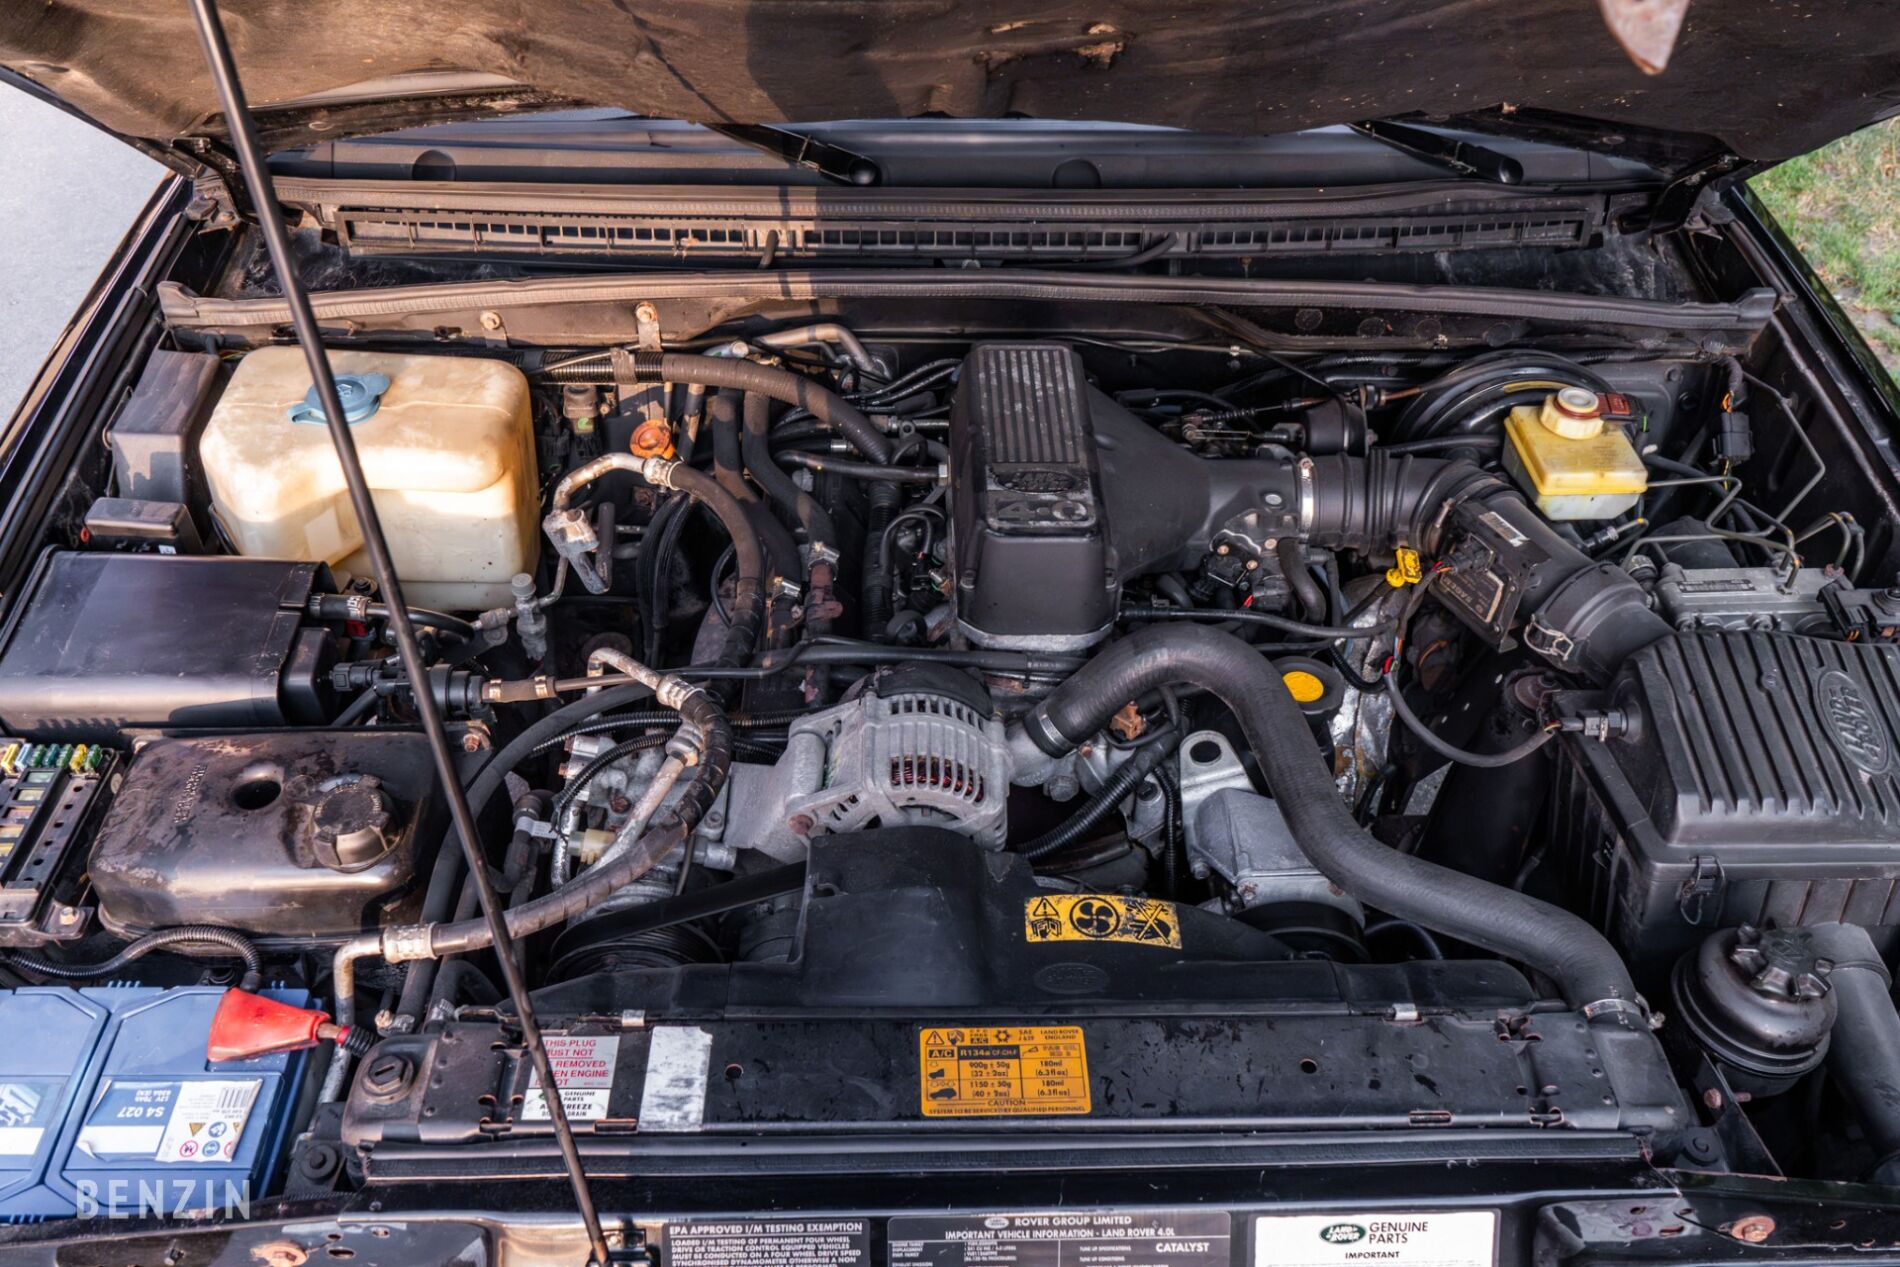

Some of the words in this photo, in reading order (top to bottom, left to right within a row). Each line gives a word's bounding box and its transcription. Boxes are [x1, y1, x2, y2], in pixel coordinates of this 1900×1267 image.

[544, 1039, 566, 1047] THIS
[569, 1039, 597, 1047] PLUG
[996, 1061, 1010, 1069] 50g
[117, 1106, 143, 1118] 027
[146, 1106, 166, 1117] S4
[1014, 1217, 1049, 1226] ROVER
[1052, 1216, 1090, 1226] GROUP
[1093, 1216, 1132, 1225] LIMITED
[670, 1226, 688, 1235] EPA
[690, 1225, 743, 1234] APPROVED
[745, 1224, 763, 1235] I/M
[765, 1223, 804, 1233] TESTING
[807, 1222, 863, 1232] EXEMPTION
[1369, 1222, 1429, 1233] GENUINE
[945, 1230, 996, 1240] IMPORTANT
[998, 1229, 1031, 1239] VEHICLE
[1032, 1228, 1093, 1239] INFORMATION
[1102, 1228, 1125, 1237] LAND
[1127, 1227, 1156, 1237] ROVER
[1157, 1227, 1175, 1236] 4.0L
[1369, 1233, 1408, 1244] PARTS
[781, 1243, 816, 1251] EQUIPPED
[1155, 1242, 1210, 1252] CATALYST
[1345, 1251, 1400, 1259] IMPORTANT
[672, 1259, 729, 1267] SYNCHRONISED
[731, 1258, 787, 1266] DYNAMOMETER
